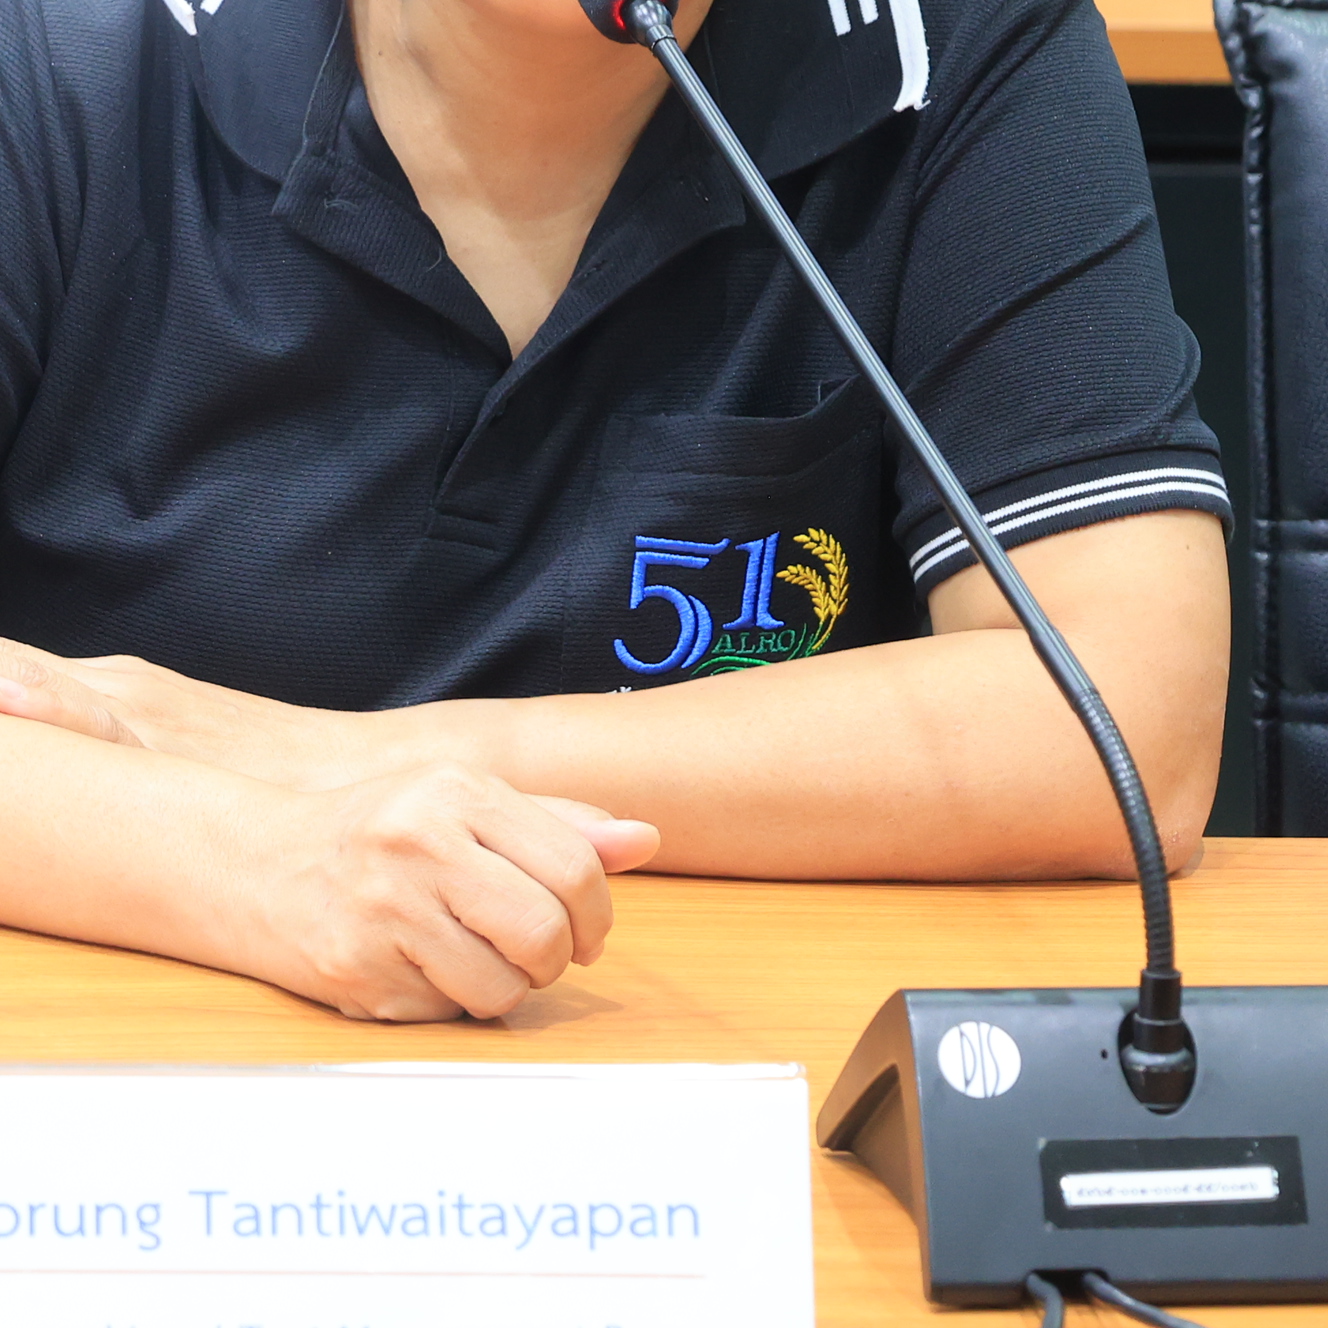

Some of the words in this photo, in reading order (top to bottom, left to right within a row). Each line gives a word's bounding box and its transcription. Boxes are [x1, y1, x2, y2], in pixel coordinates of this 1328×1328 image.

[613, 531, 785, 675] 51
[711, 629, 796, 655] ALRO
[188, 1188, 701, 1252] Tantiwaitayapan
